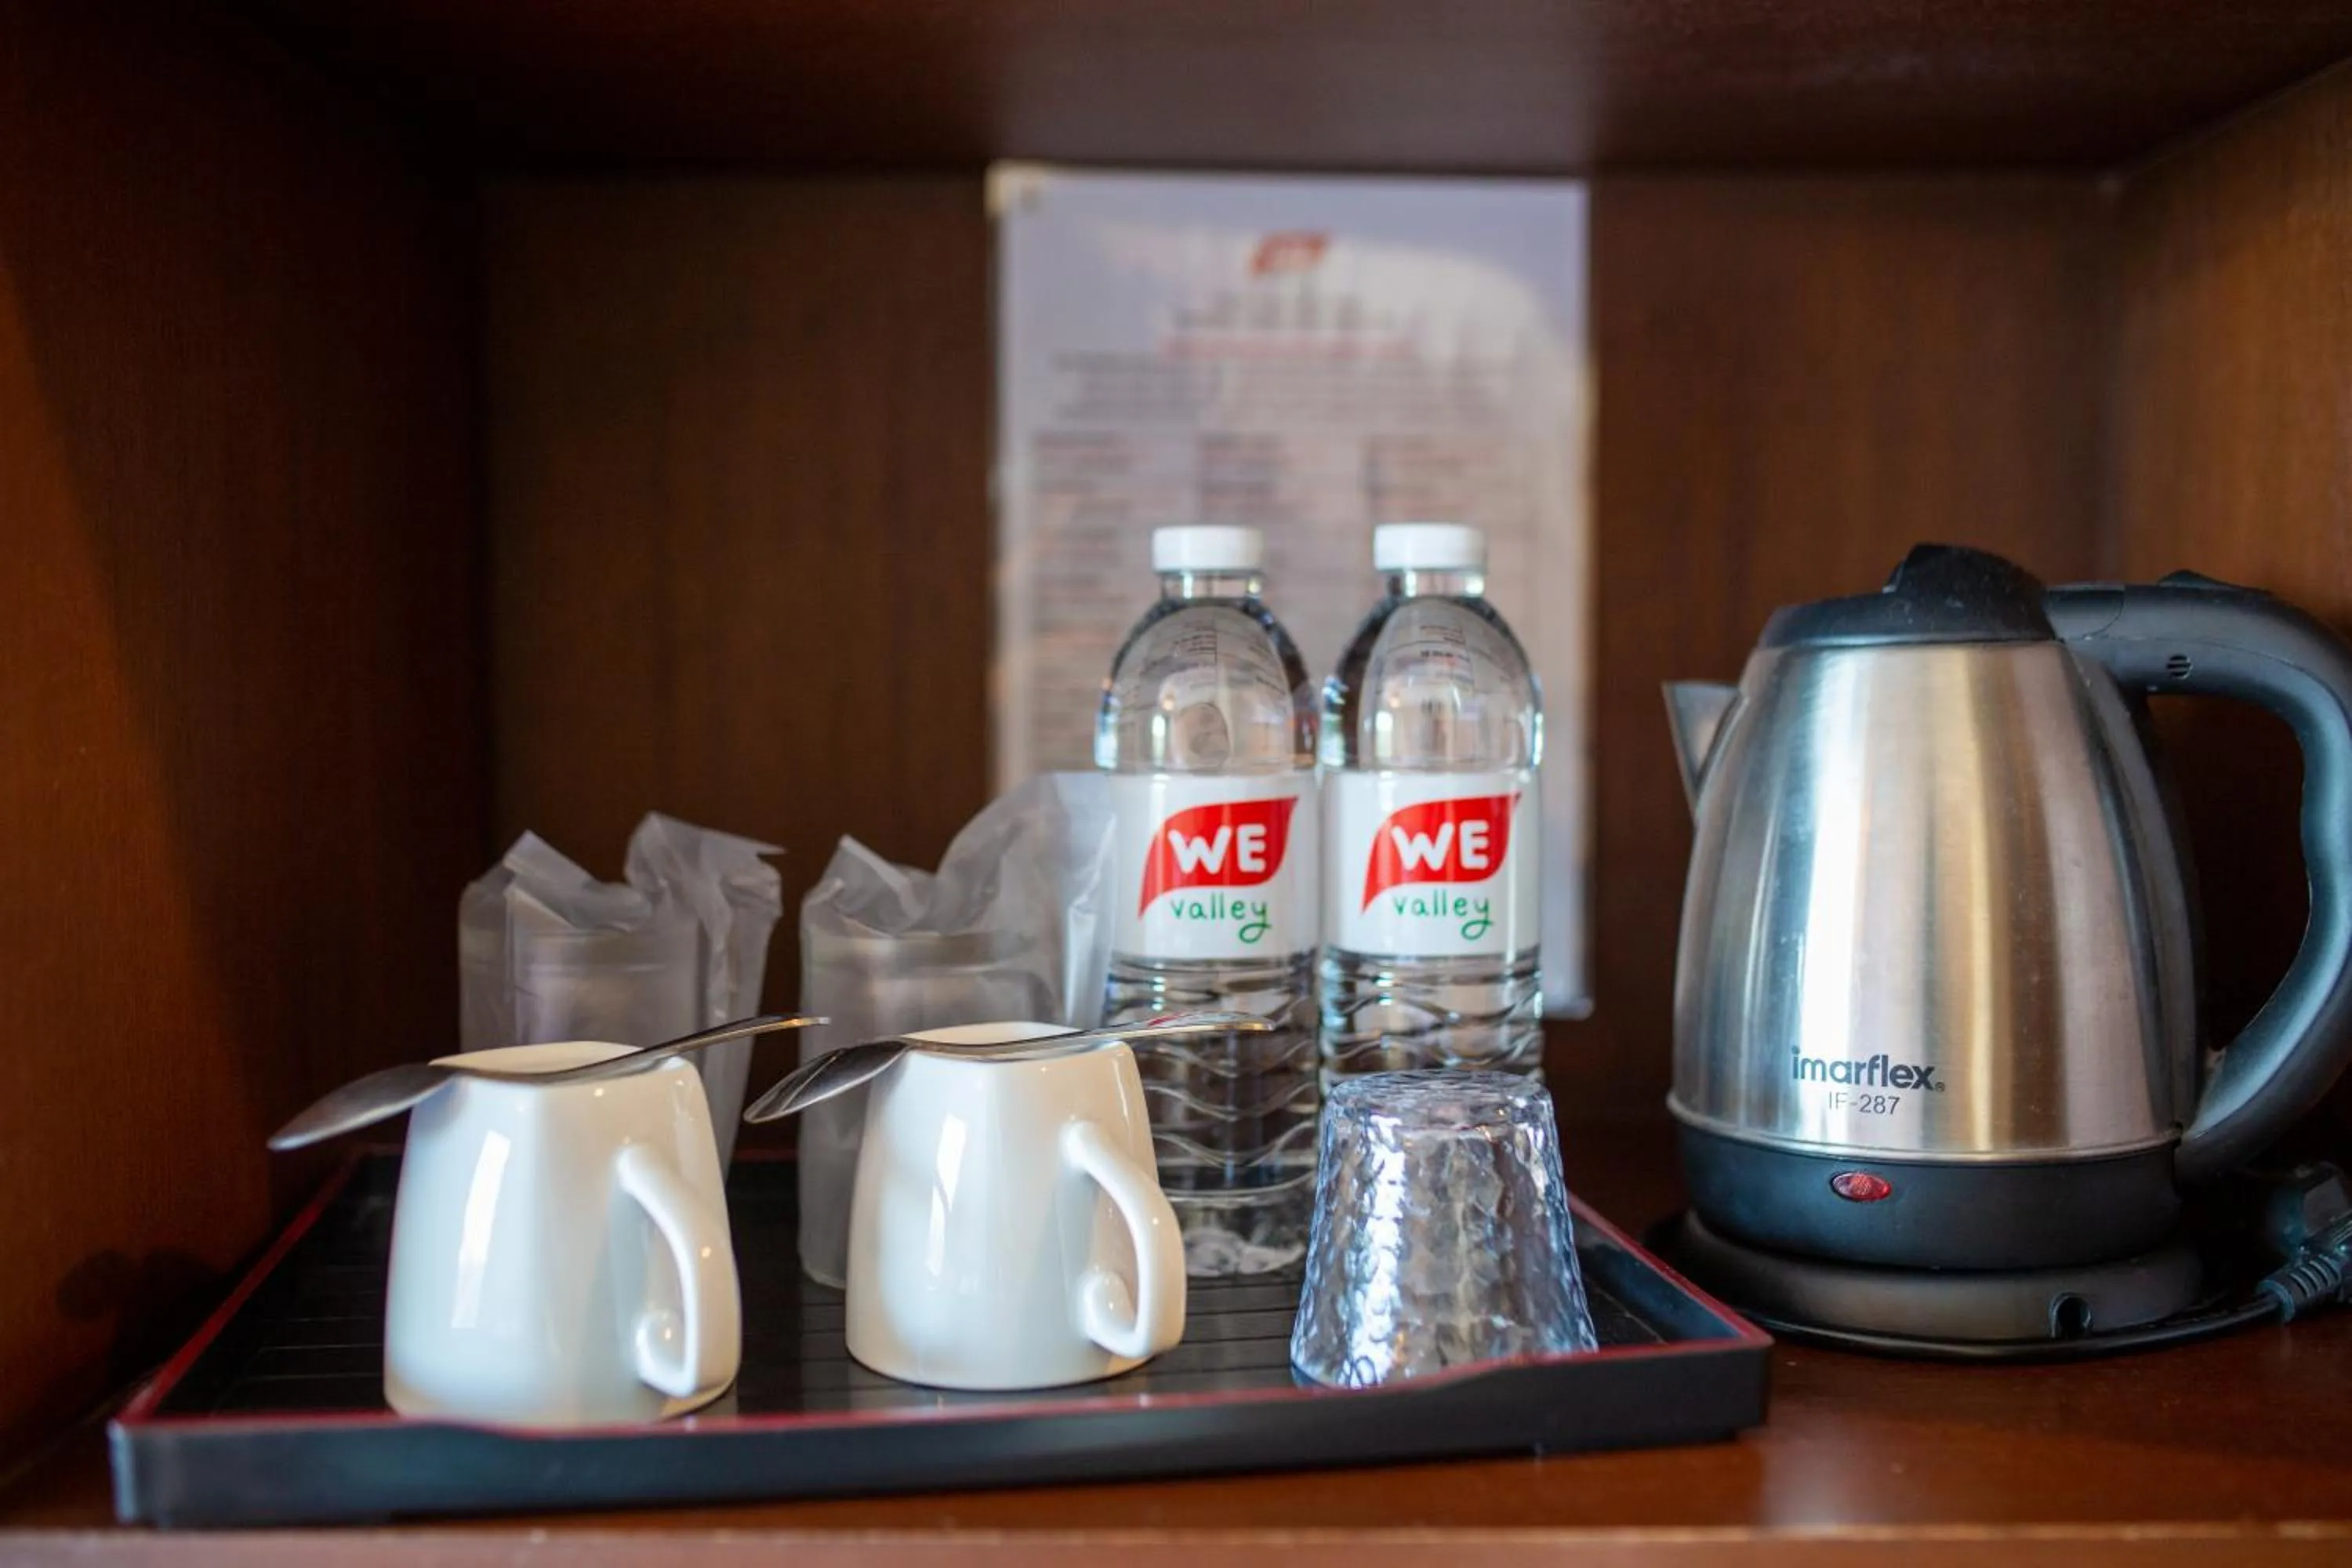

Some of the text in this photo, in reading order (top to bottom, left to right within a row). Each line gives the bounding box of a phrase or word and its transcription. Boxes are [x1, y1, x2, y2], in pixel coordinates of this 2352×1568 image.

[1167, 824, 1267, 874] WE
[1392, 820, 1489, 870] WE
[1170, 892, 1271, 944] valley
[1392, 889, 1493, 941] valley
[1791, 1045, 1936, 1092] imarflex
[1828, 1091, 1900, 1115] IF-287
